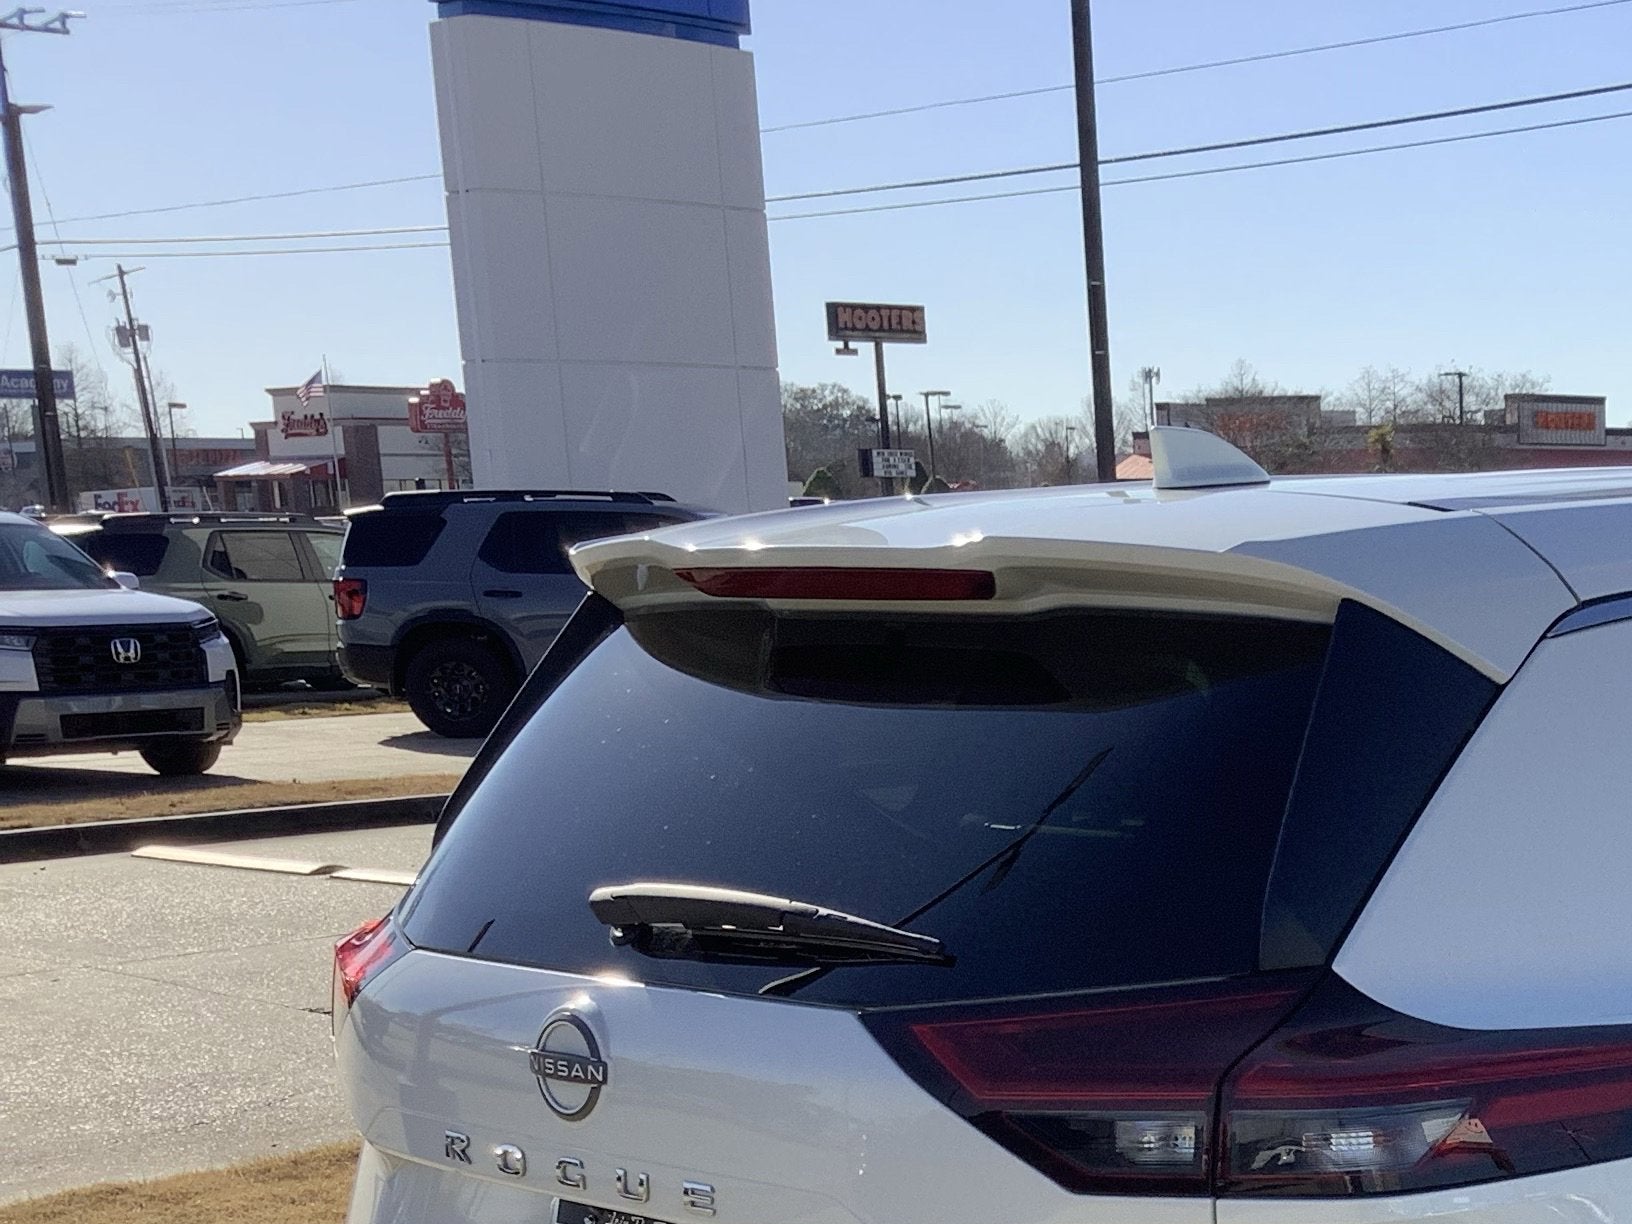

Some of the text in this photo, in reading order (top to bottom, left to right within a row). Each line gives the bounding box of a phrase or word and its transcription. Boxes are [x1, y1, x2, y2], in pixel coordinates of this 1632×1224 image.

[837, 306, 923, 331] HOOTERS
[93, 491, 140, 513] FedEx
[529, 1054, 605, 1083] NISSAN
[444, 1130, 717, 1217] ROGUE
